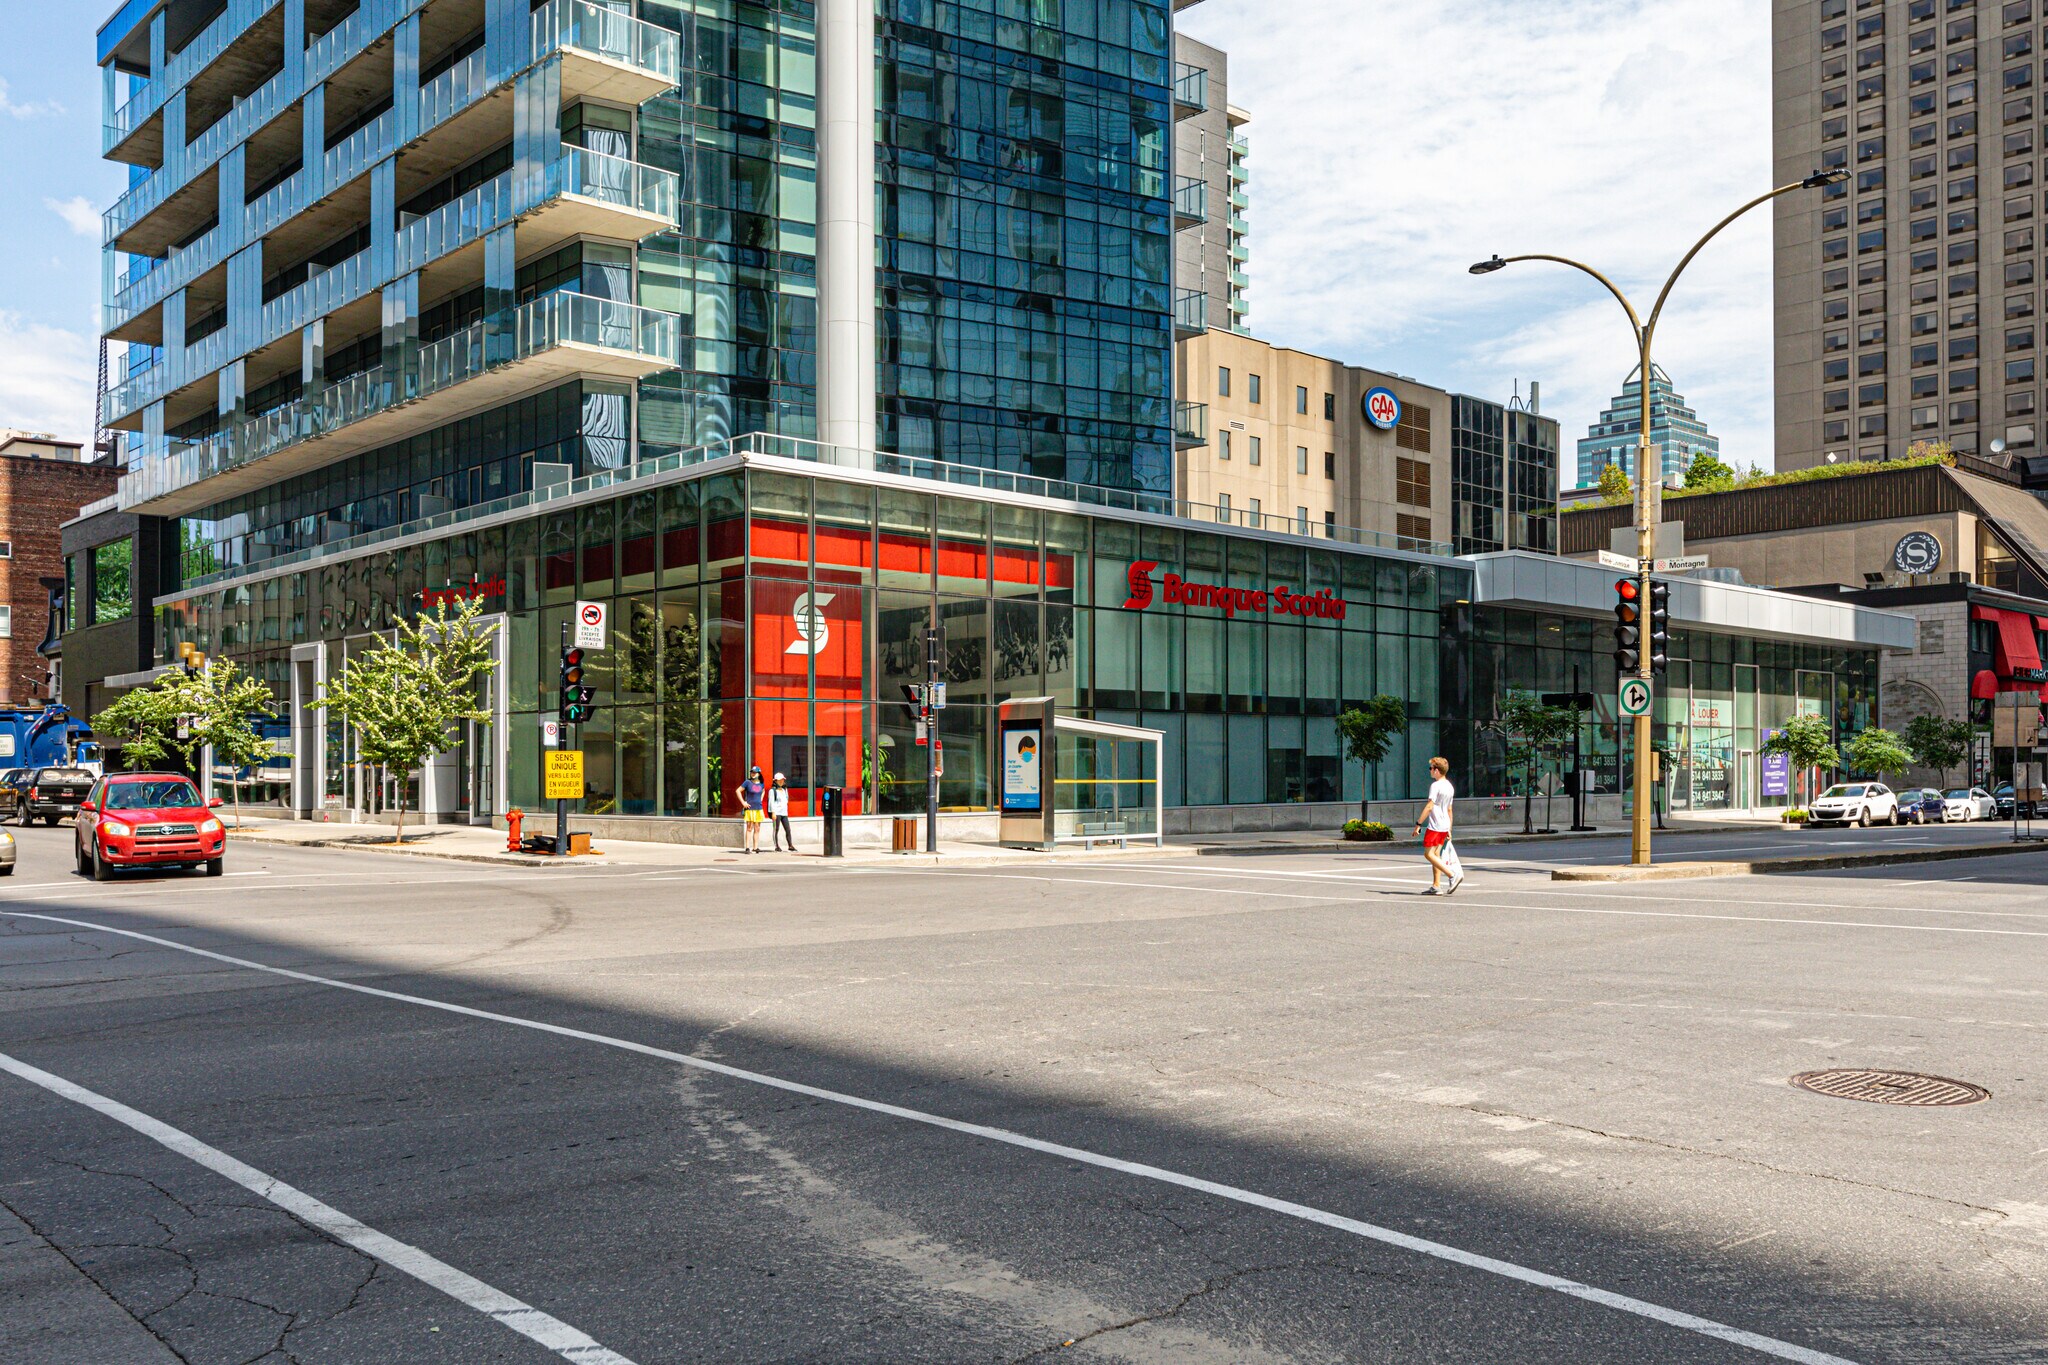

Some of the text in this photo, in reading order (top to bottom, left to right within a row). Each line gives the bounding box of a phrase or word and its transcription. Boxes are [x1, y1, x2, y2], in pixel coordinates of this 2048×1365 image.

[1372, 395, 1395, 420] CAA
[1906, 541, 1928, 565] S
[1669, 560, 1706, 569] Montagne
[422, 573, 506, 611] Banque Scotia
[1163, 573, 1346, 620] Banque Scotia
[1698, 708, 1719, 719] LOUER
[555, 753, 574, 762] SENS
[1603, 756, 1617, 766] 3835
[551, 762, 578, 771] UNIQUE
[1603, 775, 1617, 785] 3847
[1702, 770, 1711, 781] 841
[1711, 770, 1724, 781] 3835
[1702, 790, 1711, 801] 841
[1711, 790, 1724, 801] 3847
